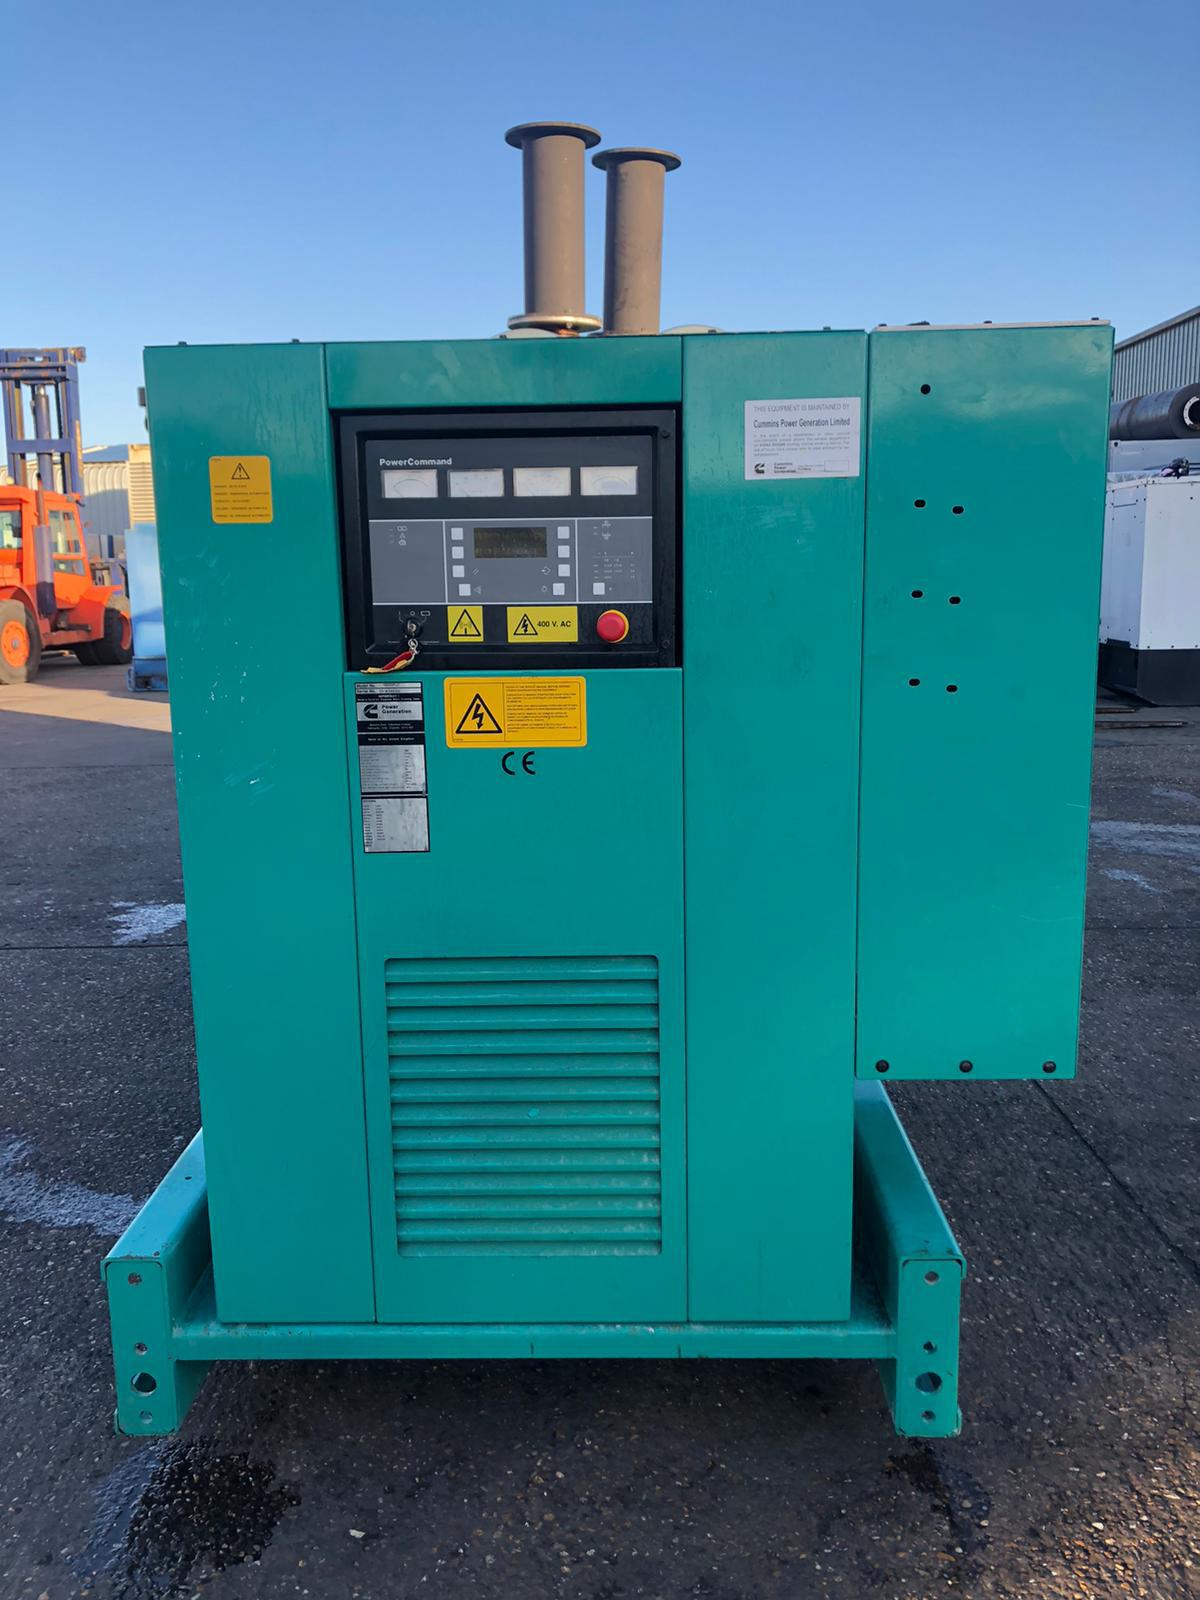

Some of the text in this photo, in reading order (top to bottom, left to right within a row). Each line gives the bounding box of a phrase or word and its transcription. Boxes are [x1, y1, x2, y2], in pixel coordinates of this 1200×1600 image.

[753, 417, 850, 428] Cummins Power Generation Limited
[379, 457, 453, 466] PowerCommand
[501, 751, 536, 775] CE
